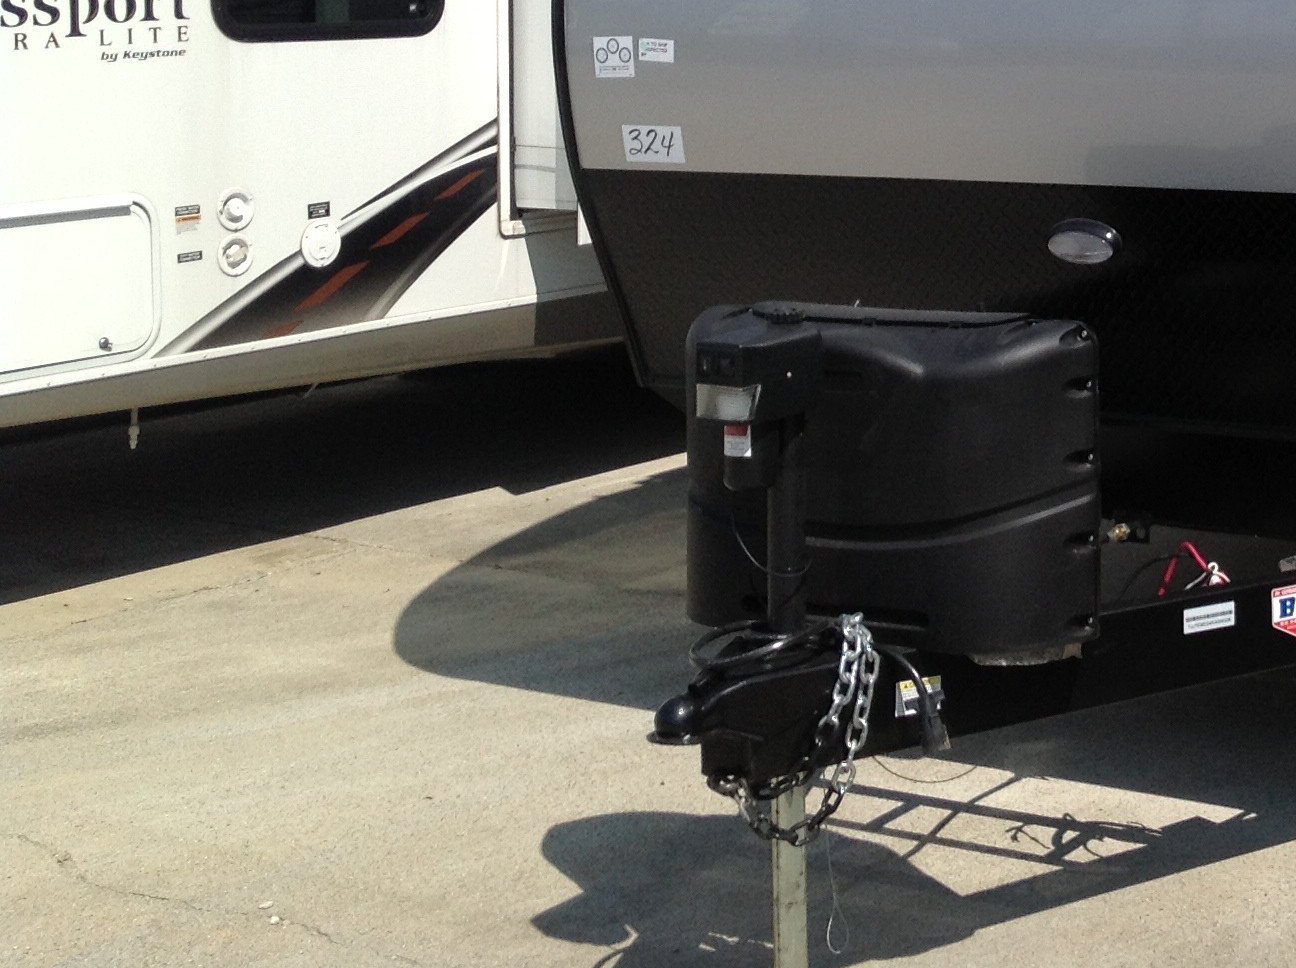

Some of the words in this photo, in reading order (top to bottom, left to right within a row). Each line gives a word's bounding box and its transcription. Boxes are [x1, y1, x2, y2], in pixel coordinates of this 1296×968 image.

[99, 25, 190, 46] LITE
[100, 51, 119, 63] by
[122, 49, 187, 61] Keystone
[628, 128, 674, 157] 324
